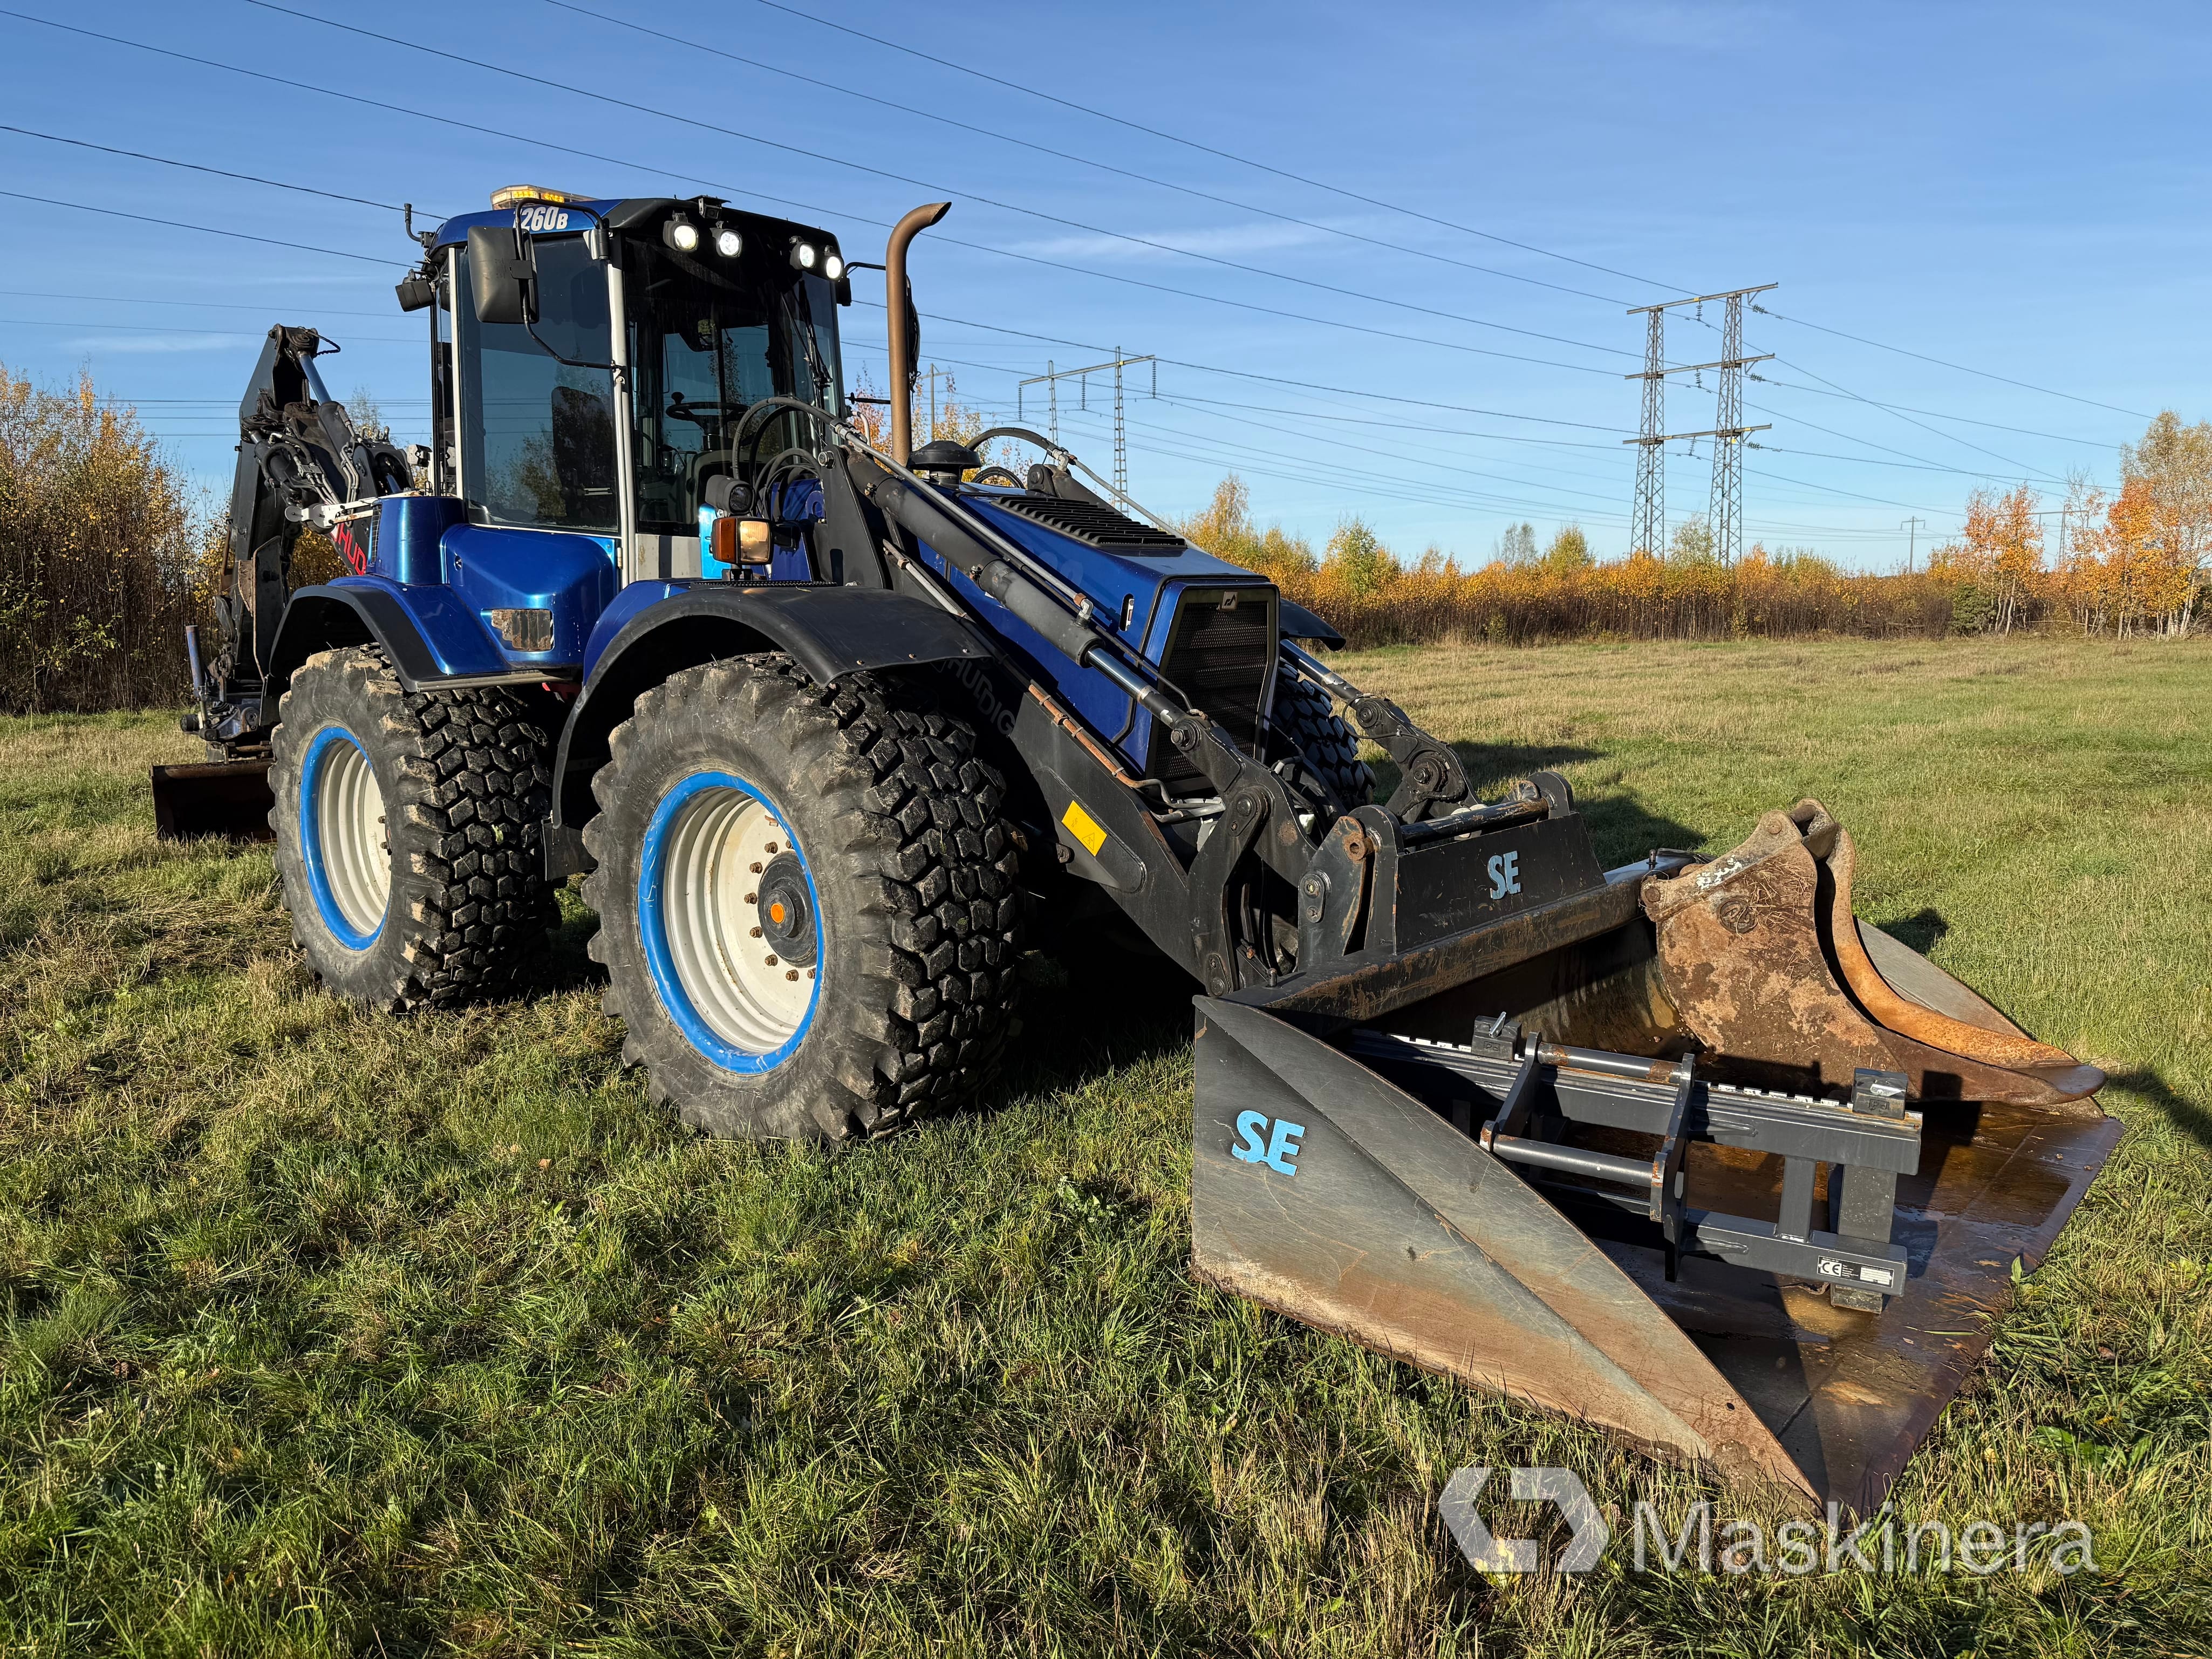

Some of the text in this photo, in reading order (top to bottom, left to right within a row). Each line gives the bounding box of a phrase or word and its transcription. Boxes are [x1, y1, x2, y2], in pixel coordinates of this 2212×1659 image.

[1487, 850, 1521, 899] SE
[1232, 1110, 1305, 1177] SE
[1822, 1262, 1840, 1275] CE
